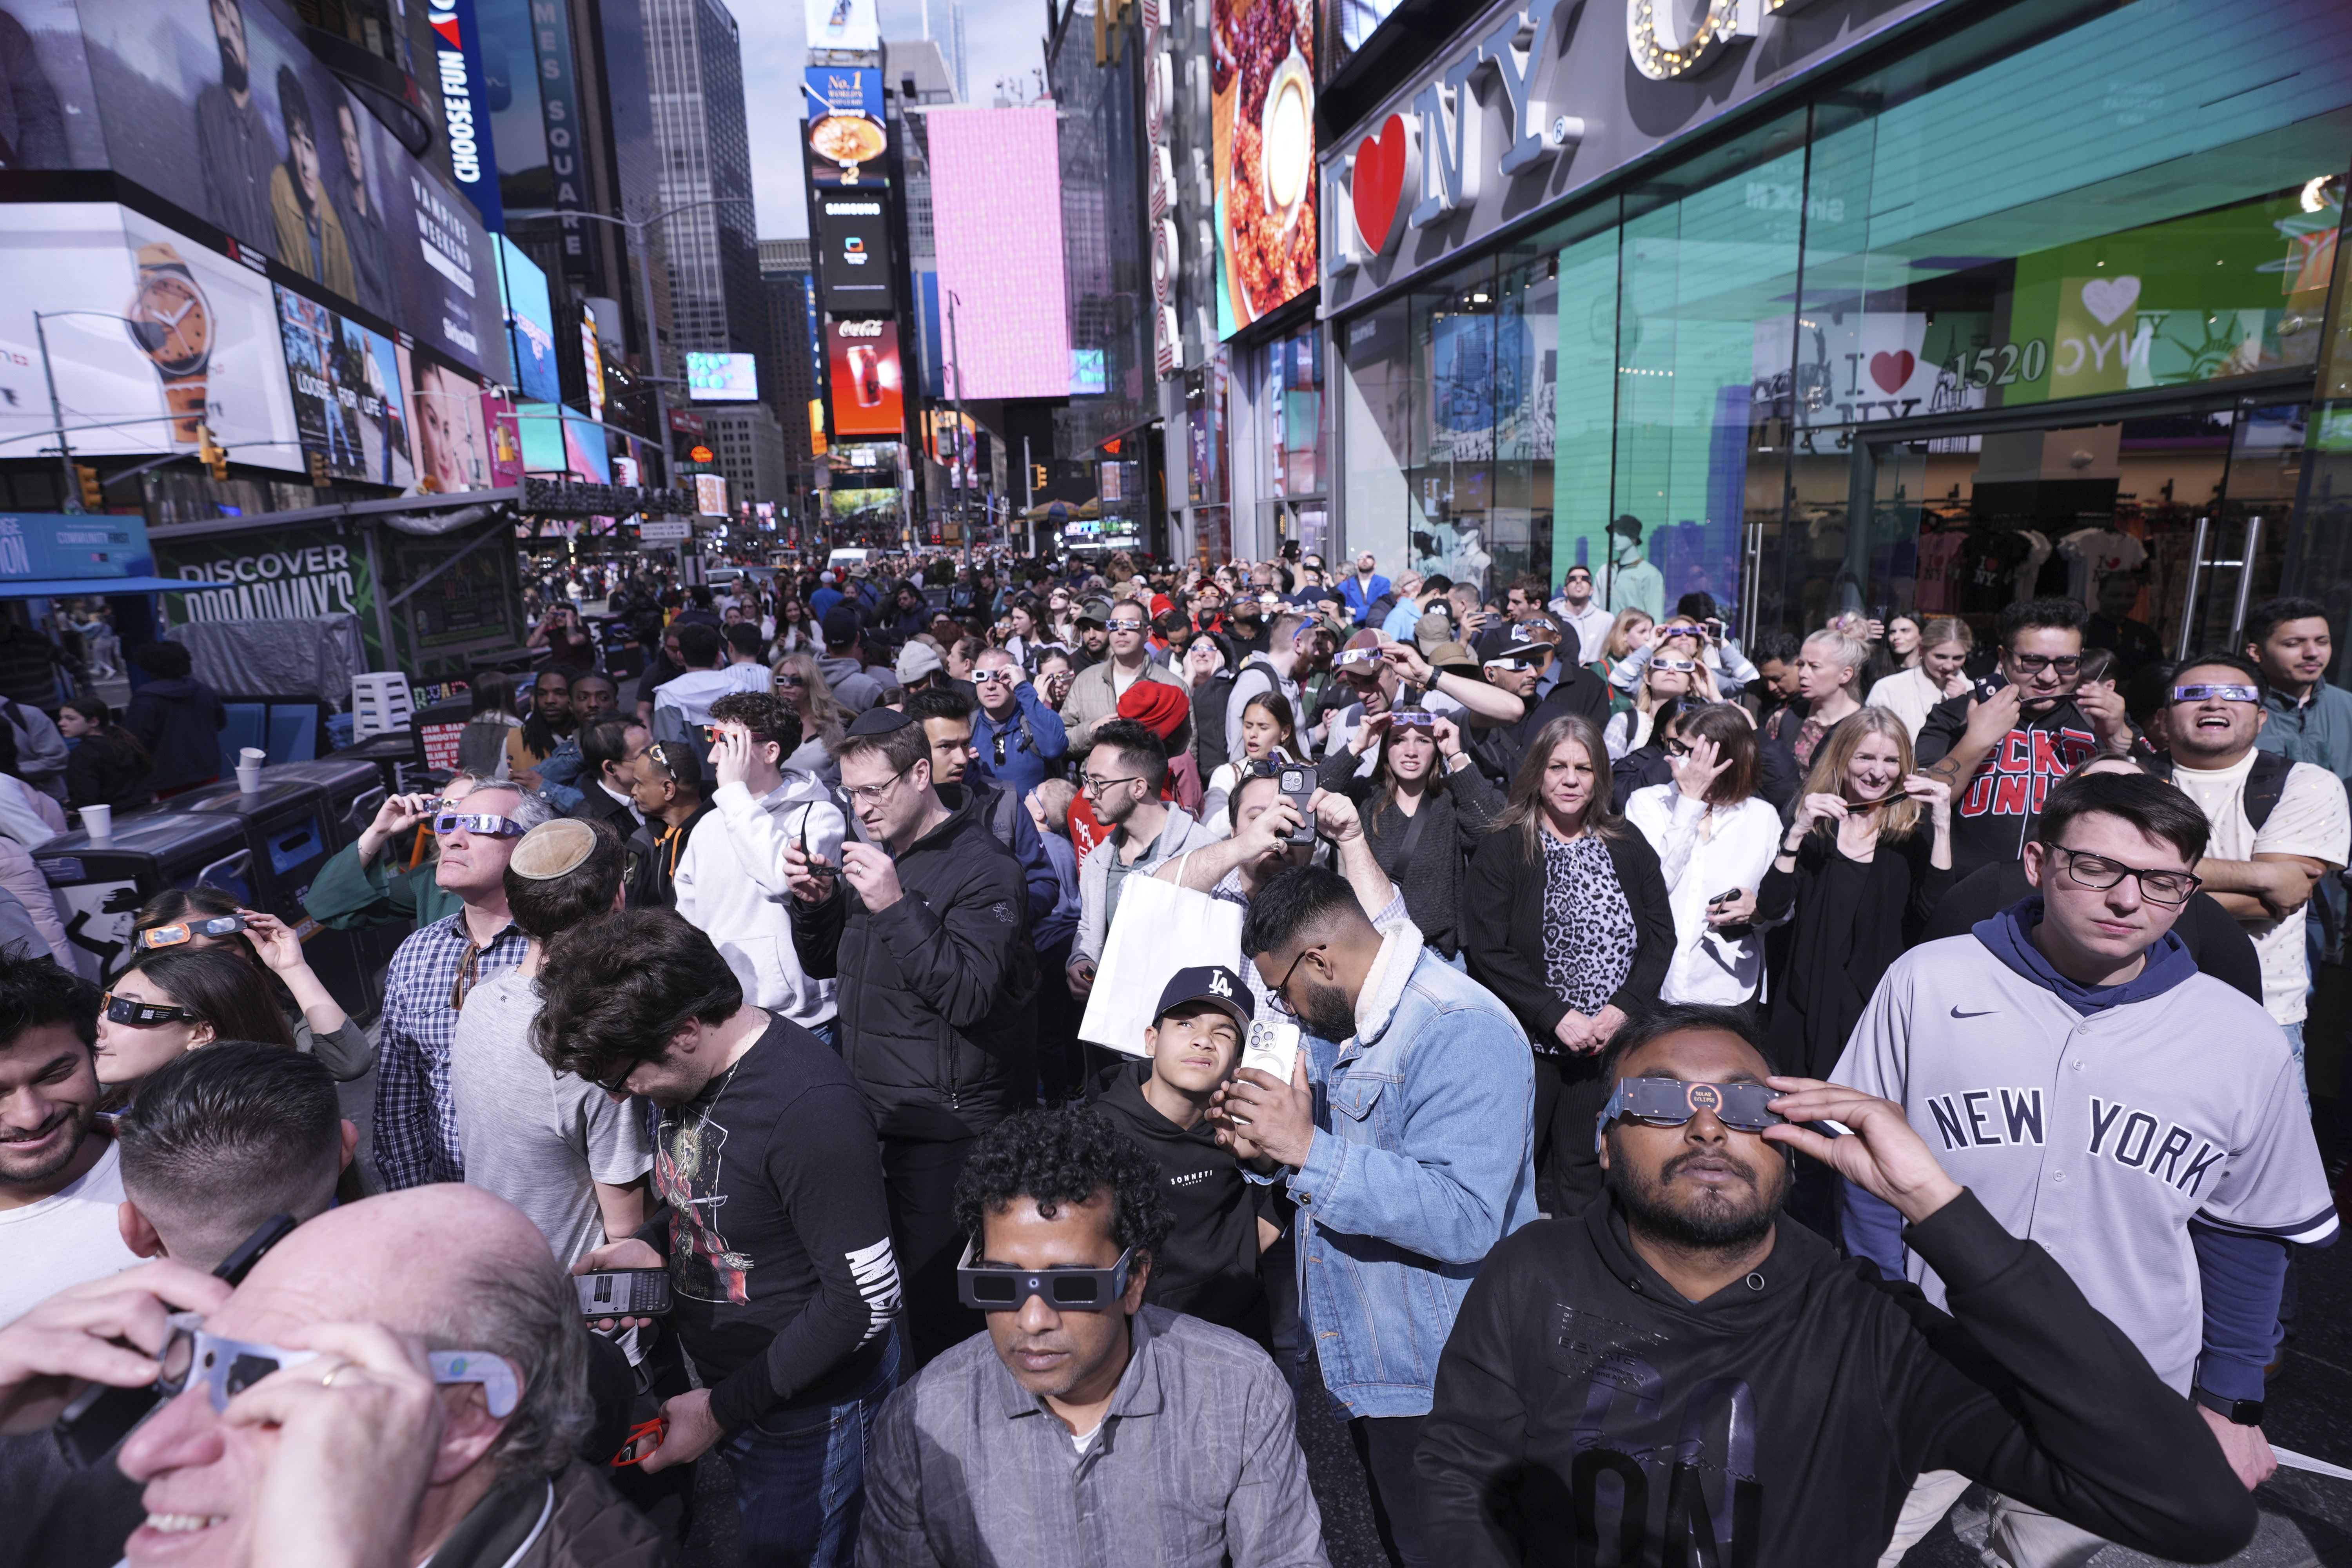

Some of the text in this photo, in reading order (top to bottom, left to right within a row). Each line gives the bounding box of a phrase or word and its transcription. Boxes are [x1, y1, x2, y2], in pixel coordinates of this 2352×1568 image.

[437, 50, 470, 97] FUN
[445, 97, 481, 183] CHOOSE
[1326, 154, 1352, 278] I
[1409, 0, 1559, 230] NY
[548, 100, 582, 256] SQUARE
[410, 175, 469, 247] VAMPIRE
[825, 203, 881, 215] SAMSUNG
[416, 208, 472, 273] WEEKEND
[1844, 352, 1865, 396] I
[1953, 339, 2047, 391] 1520
[295, 372, 333, 401] LOOSE
[336, 385, 359, 410] FOR
[361, 394, 382, 417] LIFE
[178, 543, 349, 584] DISCOVER
[1973, 569, 1998, 587] NY
[420, 722, 466, 734] JAM BAD
[423, 732, 462, 743] SMOOTH
[443, 742, 459, 750] JEAN
[426, 751, 449, 760] BLAME
[427, 760, 449, 769] CAN
[1209, 969, 1233, 998] LA
[1924, 1086, 2229, 1200] NEW YORK
[1171, 1169, 1212, 1185] SONNETI
